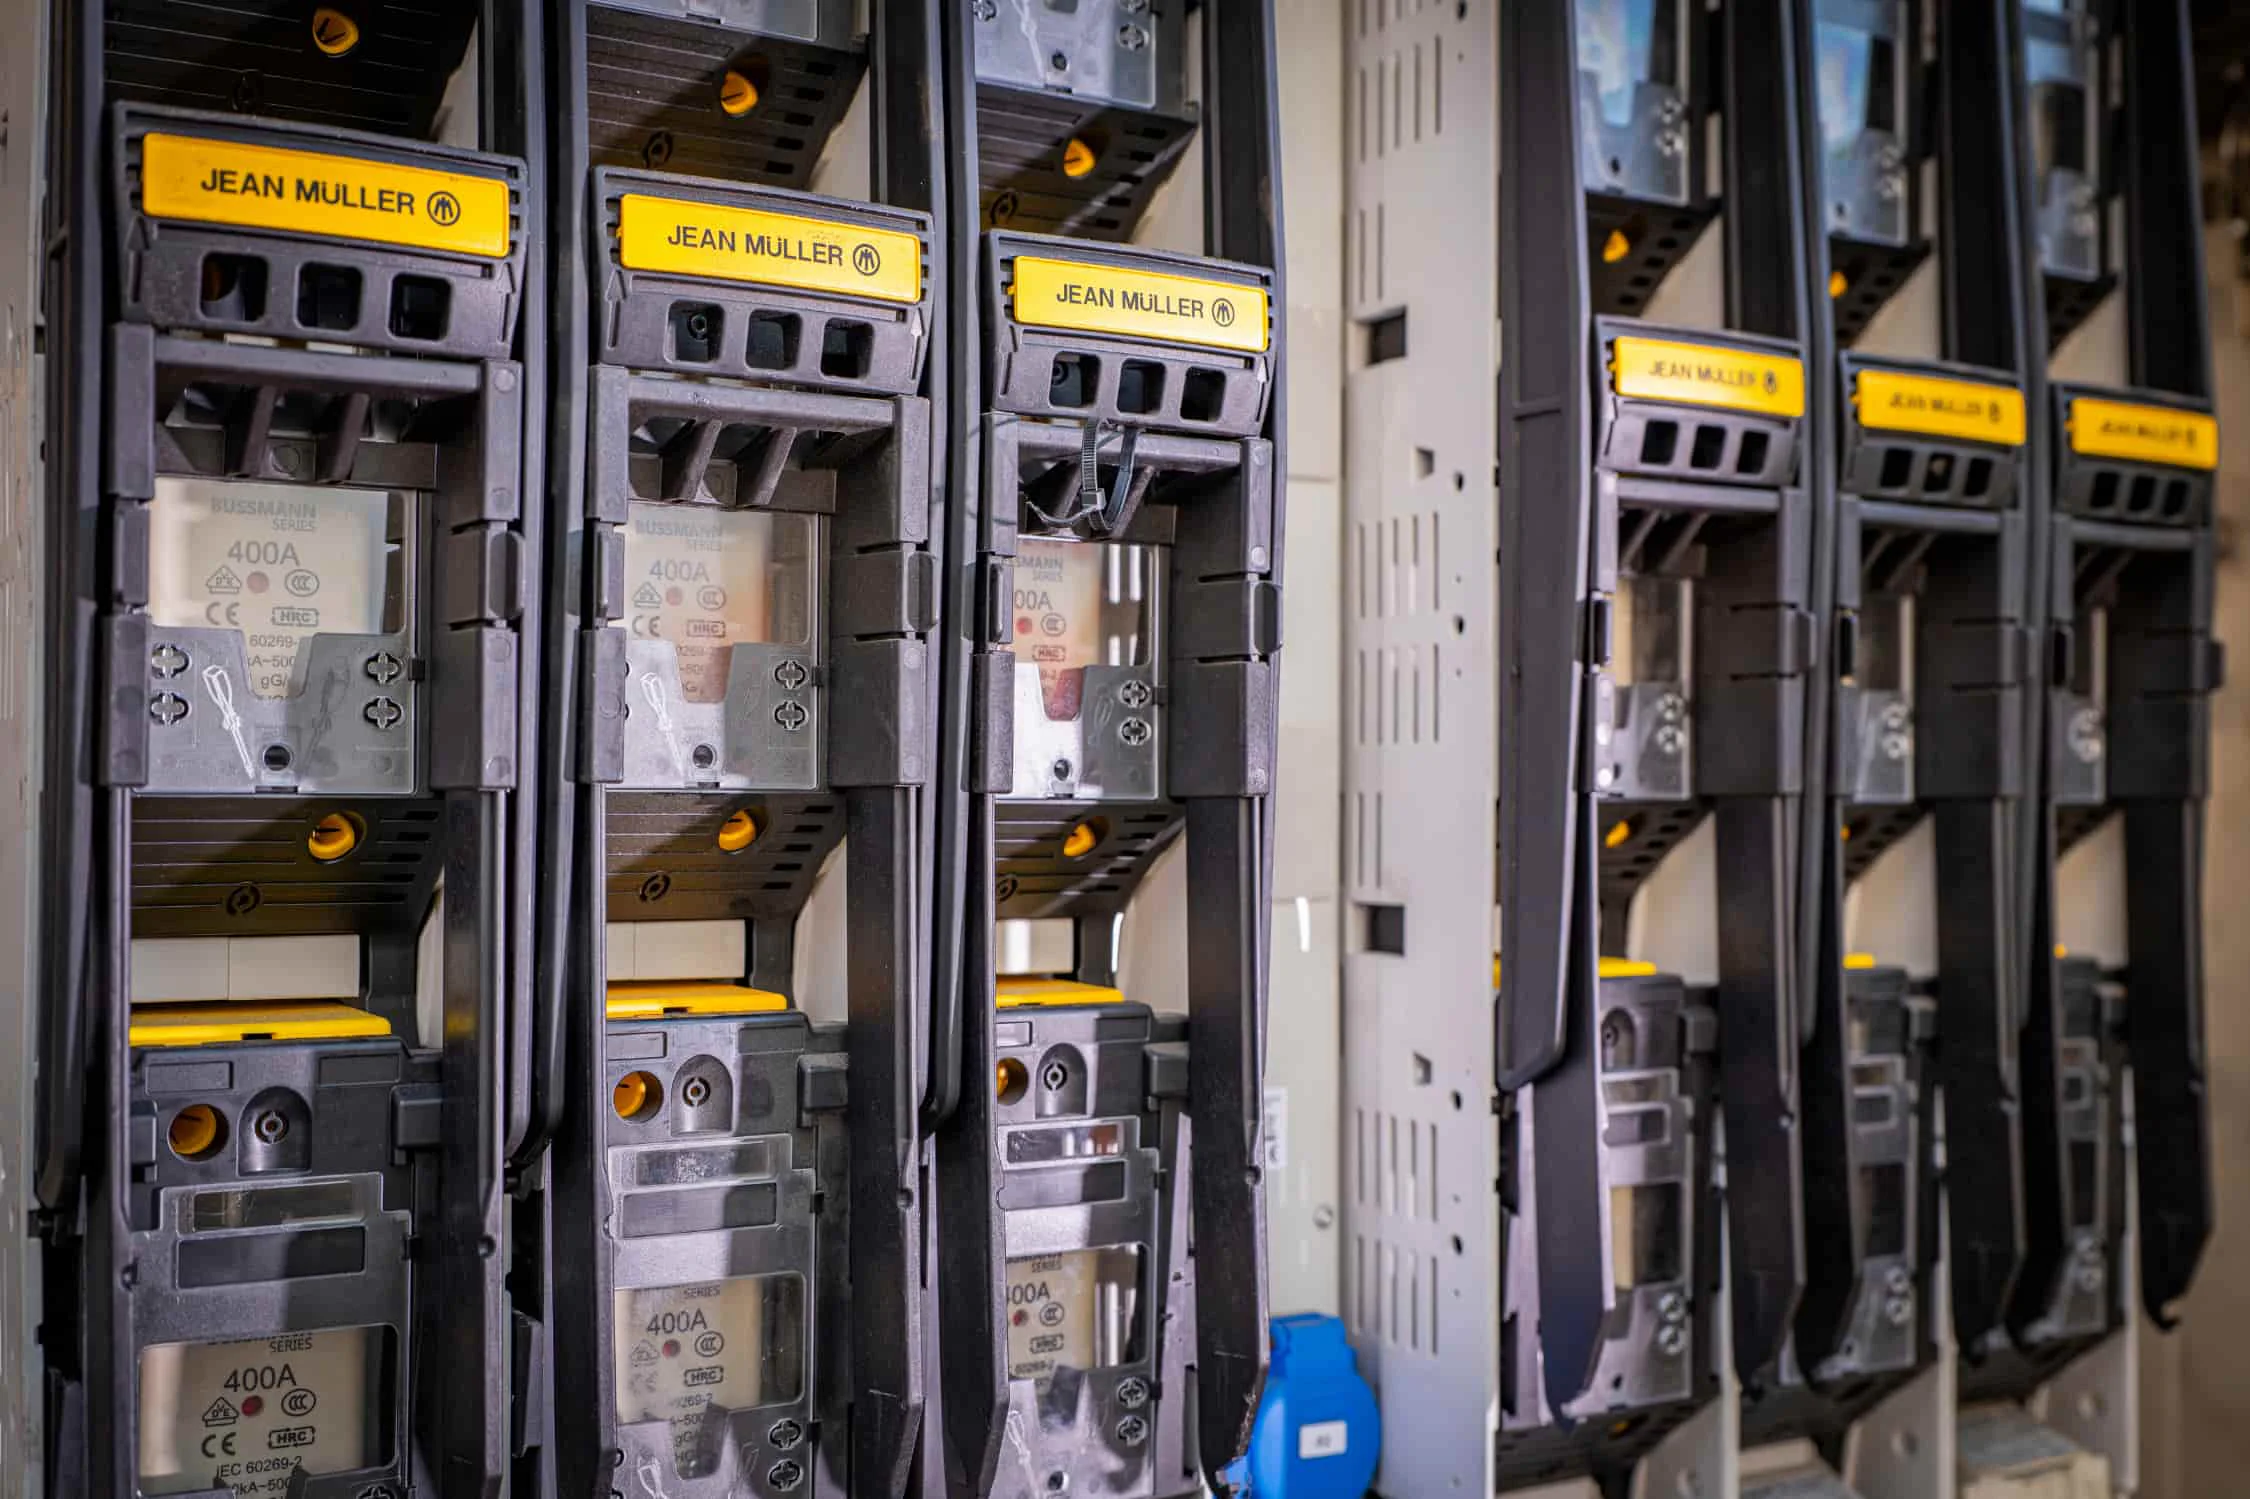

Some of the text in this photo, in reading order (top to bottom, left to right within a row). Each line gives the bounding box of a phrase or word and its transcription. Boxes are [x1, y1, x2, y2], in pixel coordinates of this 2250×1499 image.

[201, 168, 415, 216] JEAN MÜLLER
[667, 224, 843, 267] JEAN MÜLLER
[1056, 283, 1204, 319] JEAN MÜLLER
[1648, 360, 1692, 379] JEAN
[211, 497, 318, 519] BUSSMANN
[272, 518, 316, 532] SERIES
[228, 540, 300, 567] 400A
[650, 559, 710, 583] 400A
[205, 602, 240, 626] CE
[280, 610, 312, 623] HRC
[647, 1308, 708, 1336] 400A
[270, 1336, 313, 1353] SERIES
[224, 1364, 297, 1393] 400A
[690, 1368, 718, 1383] HRC
[201, 1432, 237, 1459] CE
[276, 1430, 308, 1444] HRC
[216, 1463, 242, 1478] IEC
